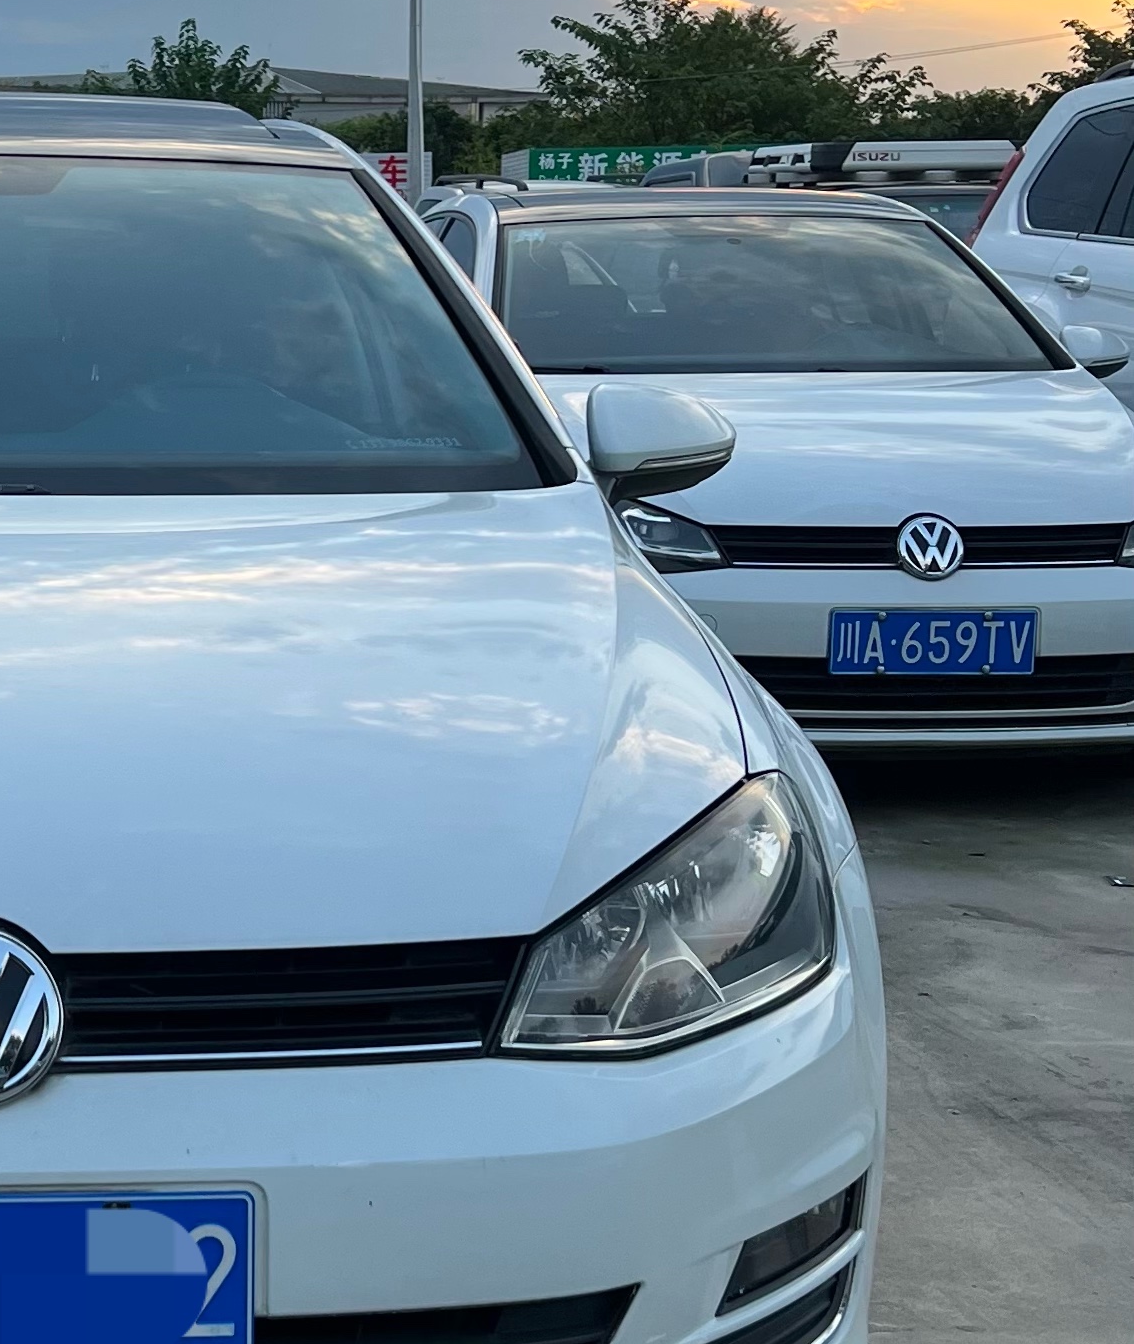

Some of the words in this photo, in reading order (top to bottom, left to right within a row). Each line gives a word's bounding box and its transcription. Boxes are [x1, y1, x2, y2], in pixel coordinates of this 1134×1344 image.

[378, 155, 408, 189] 车
[852, 152, 901, 162] ISUZU
[837, 620, 1031, 664] 川A·659TV
